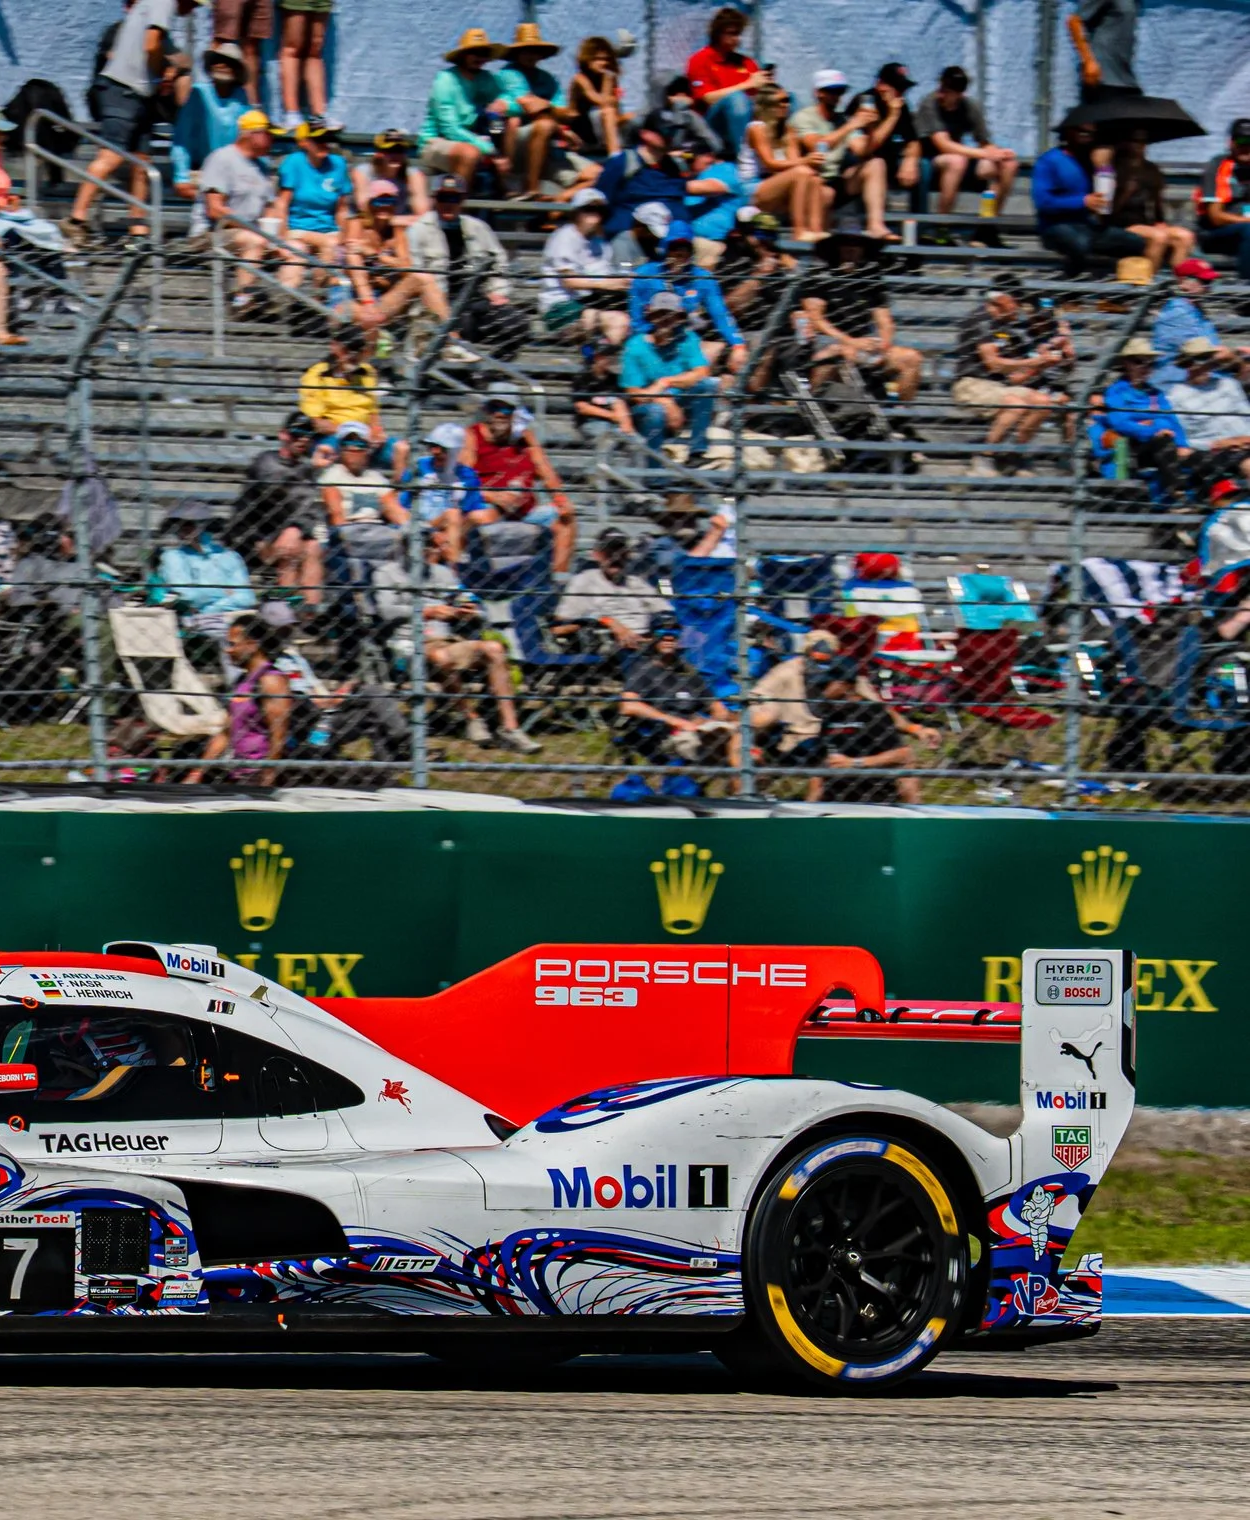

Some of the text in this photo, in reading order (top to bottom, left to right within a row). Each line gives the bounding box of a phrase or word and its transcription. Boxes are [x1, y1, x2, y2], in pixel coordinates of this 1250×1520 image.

[167, 952, 209, 975] Mobil
[212, 962, 224, 977] 1
[535, 958, 807, 987] PORSCHE
[534, 986, 638, 1007] 963
[1064, 987, 1101, 998] BOSCH
[1036, 1091, 1103, 1110] Mobil 1
[1056, 1129, 1087, 1143] TAG
[1055, 1146, 1089, 1167] HEUER
[546, 1164, 715, 1209] Mobil 1
[3, 1238, 38, 1300] 7
[393, 1259, 437, 1270] GTP
